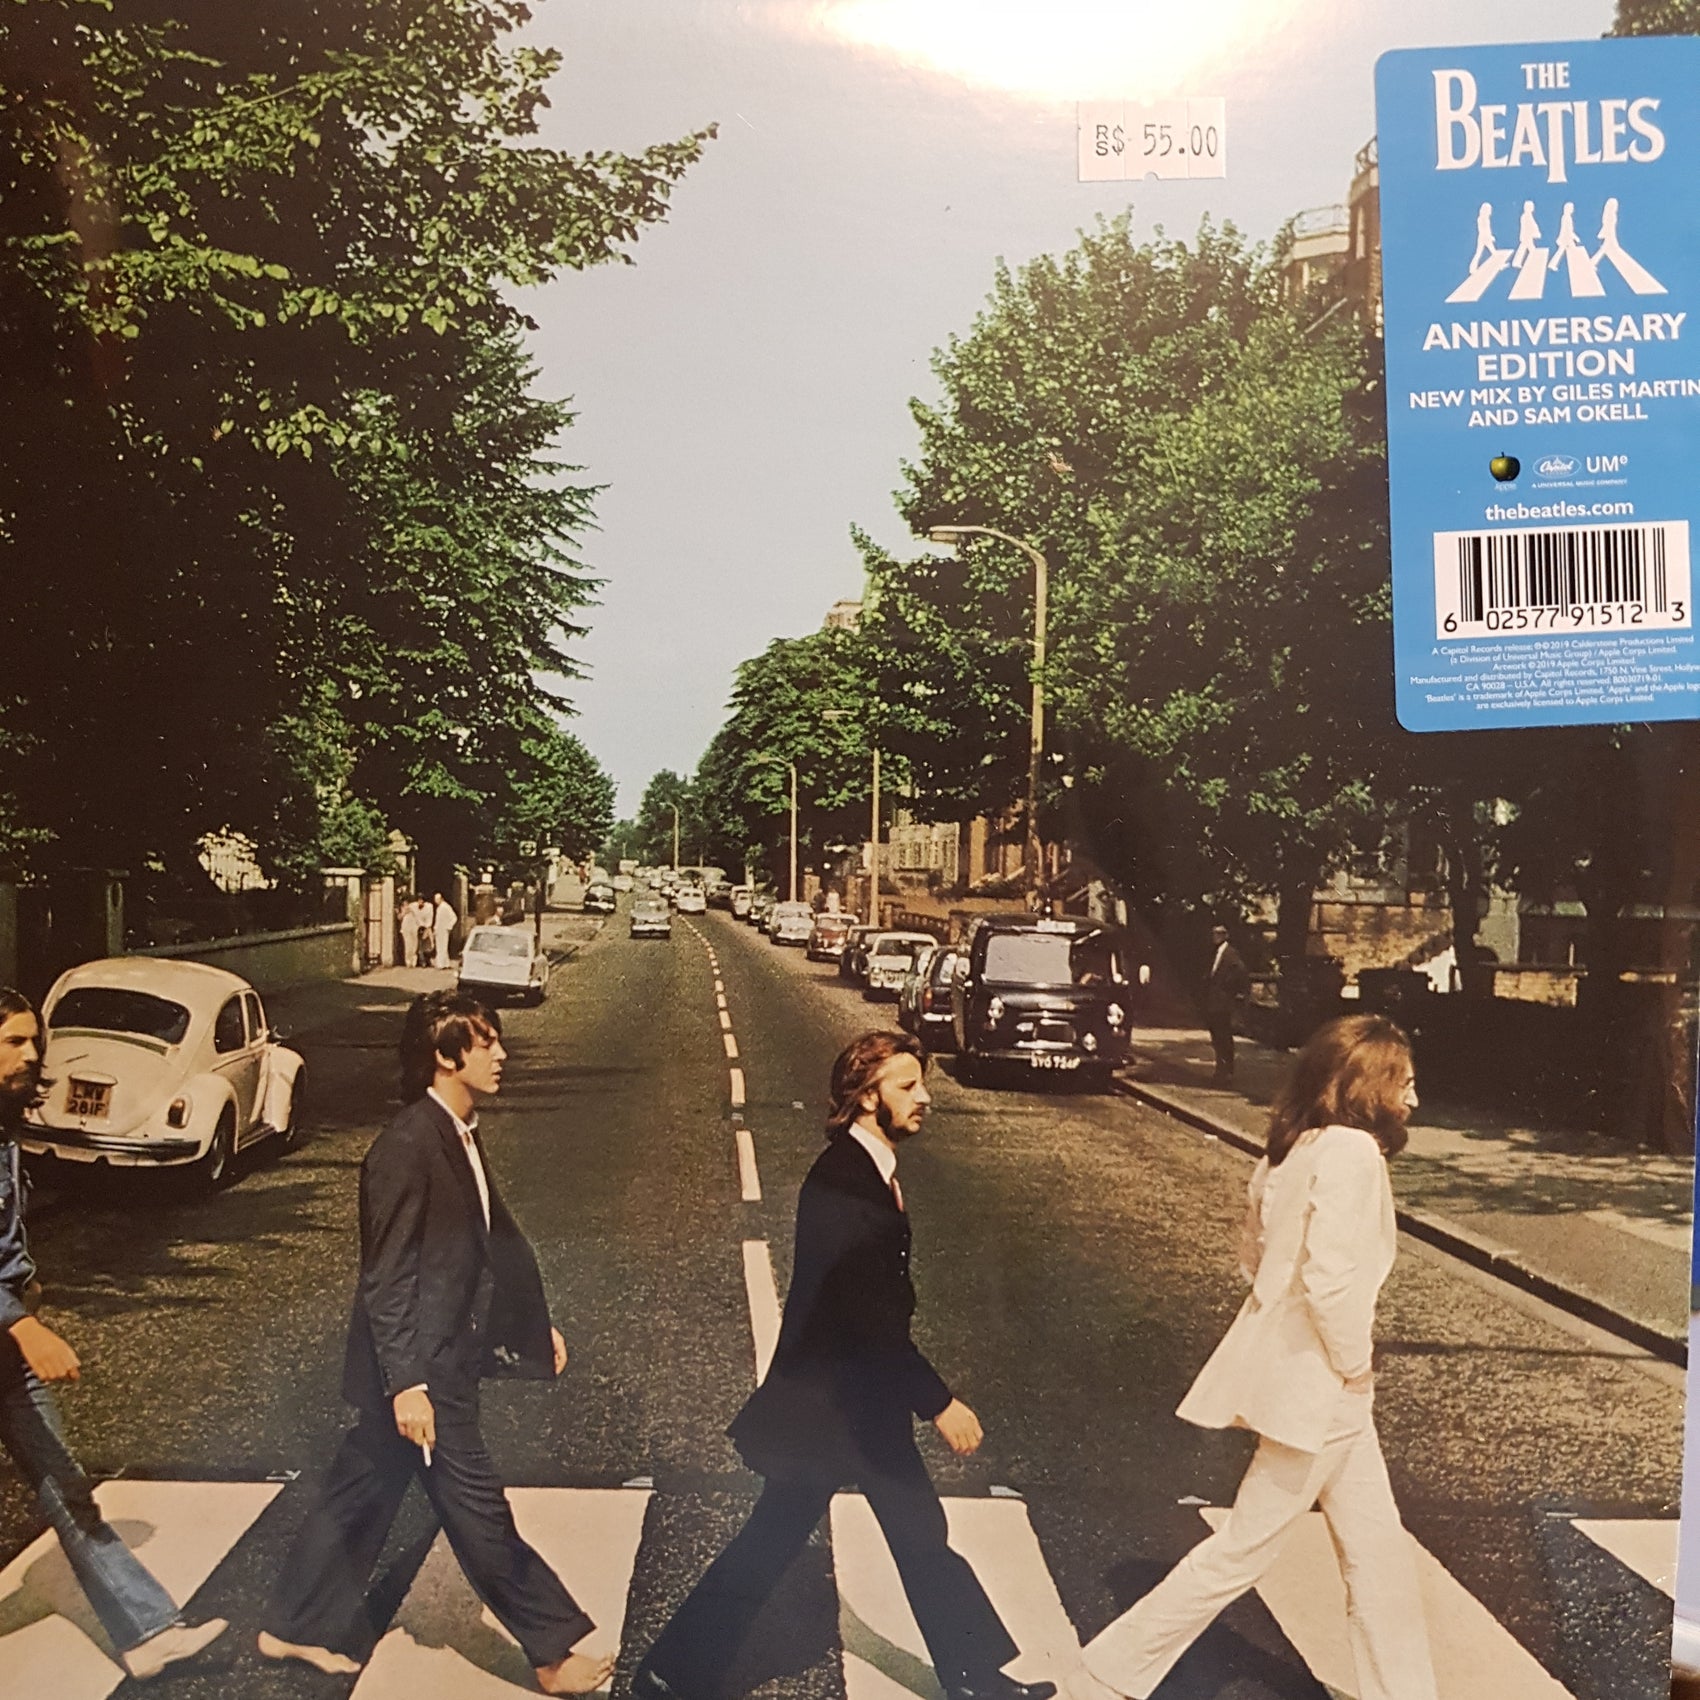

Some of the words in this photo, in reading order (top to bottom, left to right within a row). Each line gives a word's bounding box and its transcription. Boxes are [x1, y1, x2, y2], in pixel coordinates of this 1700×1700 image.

[1521, 62, 1570, 90] THE
[1432, 69, 1665, 183] BEATLES
[1144, 124, 1218, 157] 55.00
[1422, 312, 1687, 350] ANNIVERSARY
[1477, 348, 1635, 382] EDITION
[1410, 389, 1464, 408] NEW
[1470, 387, 1512, 406] MIX
[1518, 385, 1546, 404] BY
[1552, 382, 1614, 402] GILES
[1619, 378, 1700, 399] MARTIN
[1468, 409, 1519, 427] AND
[1524, 406, 1571, 424] SAM
[1577, 403, 1649, 422] OKELL
[1485, 500, 1634, 521] thebeatles.com
[1443, 612, 1458, 632] 6
[1486, 607, 1560, 630] 02577
[1571, 603, 1643, 626] 91512
[1671, 601, 1686, 621] 3
[1431, 647, 1438, 655] A
[1440, 646, 1468, 656] Capitol
[1470, 644, 1502, 652] Records
[1459, 654, 1490, 662] Division
[1492, 652, 1500, 661] of
[1502, 651, 1538, 660] Universal
[1539, 650, 1562, 659] Music
[1598, 647, 1620, 657] Apple
[1622, 646, 1646, 656] Corps
[1492, 661, 1526, 671] Artwork
[1556, 658, 1579, 668] Apple
[1580, 657, 1605, 667] Corps
[1409, 673, 1462, 685] Manufactured
[1463, 672, 1478, 681] and
[1479, 671, 1521, 680] distributed
[1523, 670, 1532, 680] by
[1534, 669, 1562, 679] Capitol
[1465, 682, 1480, 691] CA
[1539, 678, 1552, 688] All
[1553, 678, 1574, 689] rights
[1472, 690, 1512, 700] trademark
[1523, 688, 1547, 698] Apple
[1548, 687, 1572, 697] Corps
[1475, 702, 1489, 710] are
[1490, 699, 1530, 710] exclusively
[1532, 698, 1564, 707] licensed
[1564, 697, 1574, 706] to
[1575, 696, 1598, 706] Apple
[1599, 695, 1622, 705] Corps
